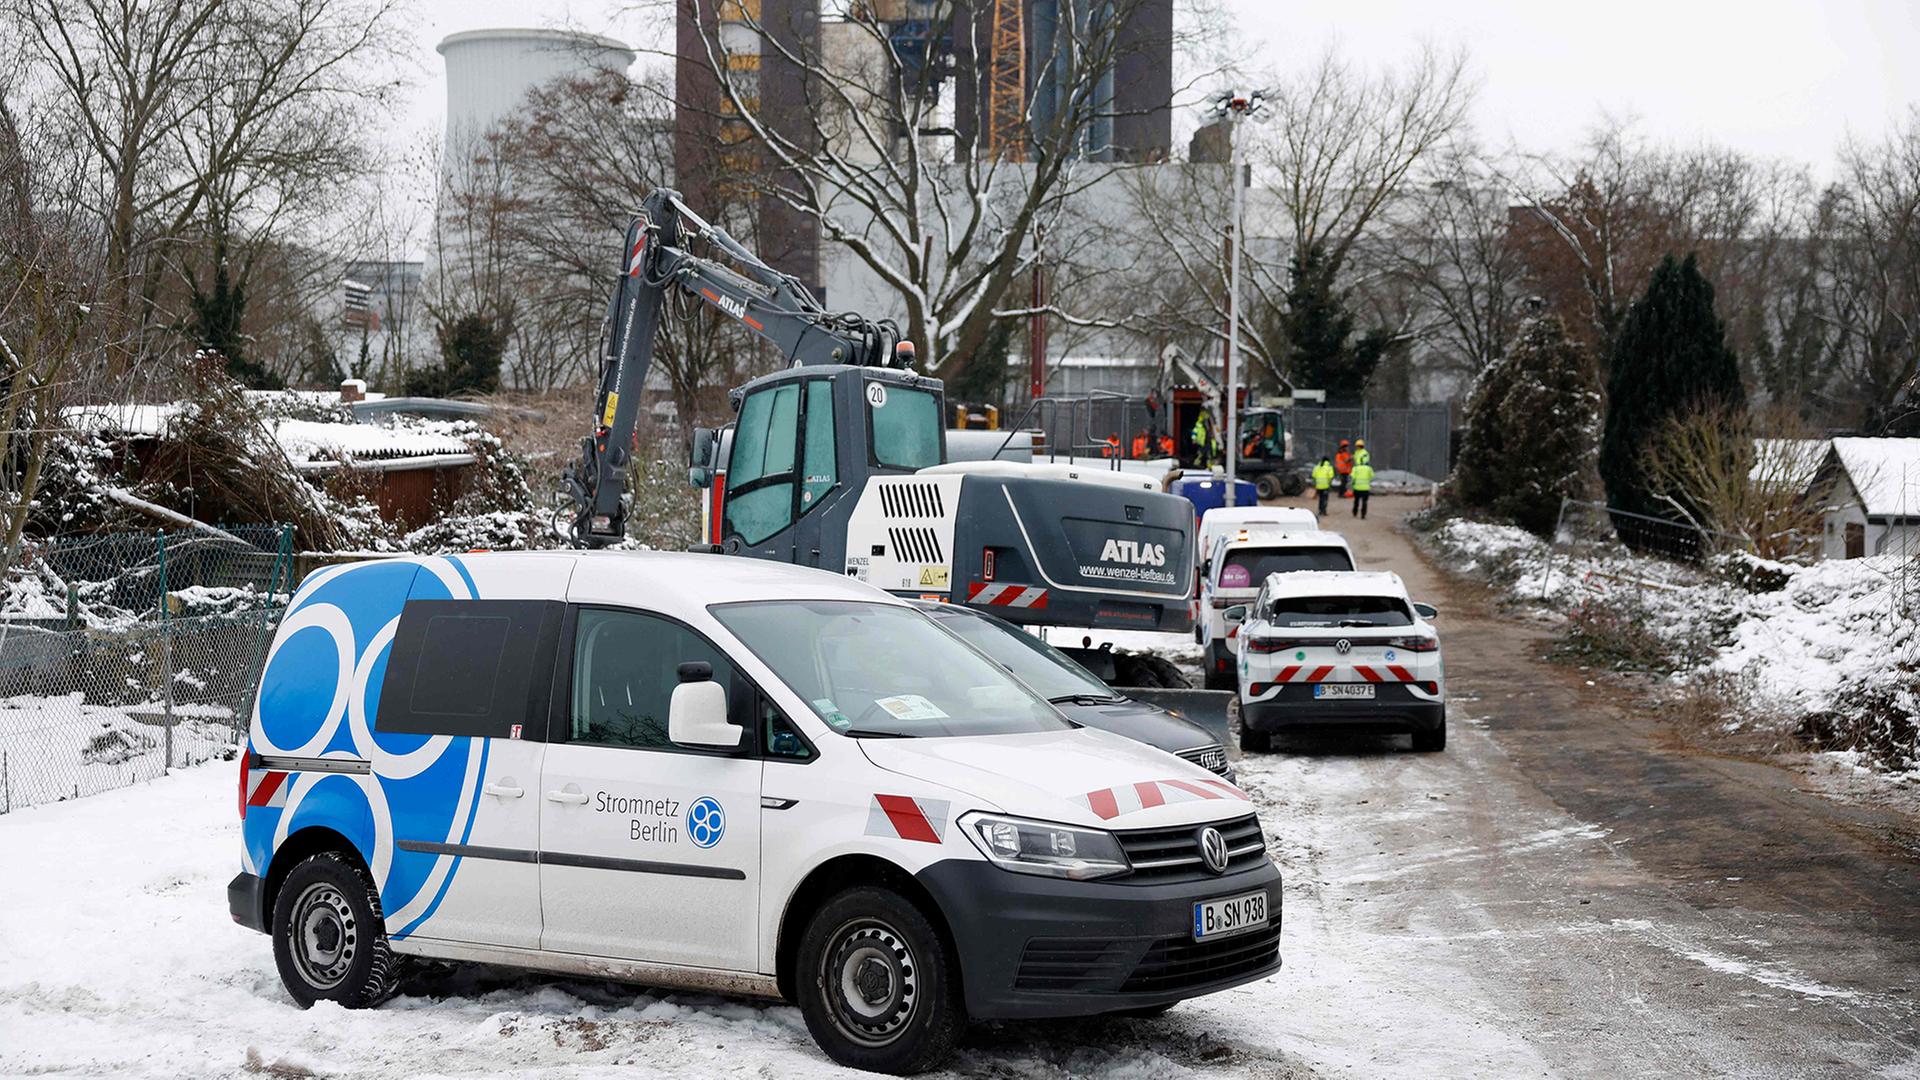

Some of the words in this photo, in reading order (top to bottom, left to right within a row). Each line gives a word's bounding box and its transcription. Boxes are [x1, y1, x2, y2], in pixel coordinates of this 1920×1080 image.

[718, 294, 746, 319] ATLAS
[870, 386, 883, 403] 20
[847, 557, 869, 566] WENZEL
[1100, 539, 1165, 567] ATLAS
[1080, 565, 1175, 583] www.wenzel-tiefbau.de
[595, 790, 680, 817] Stromnetz
[630, 819, 678, 844] Berlin
[1206, 905, 1215, 931] B
[1224, 901, 1241, 928] SN
[1245, 896, 1264, 924] 938
